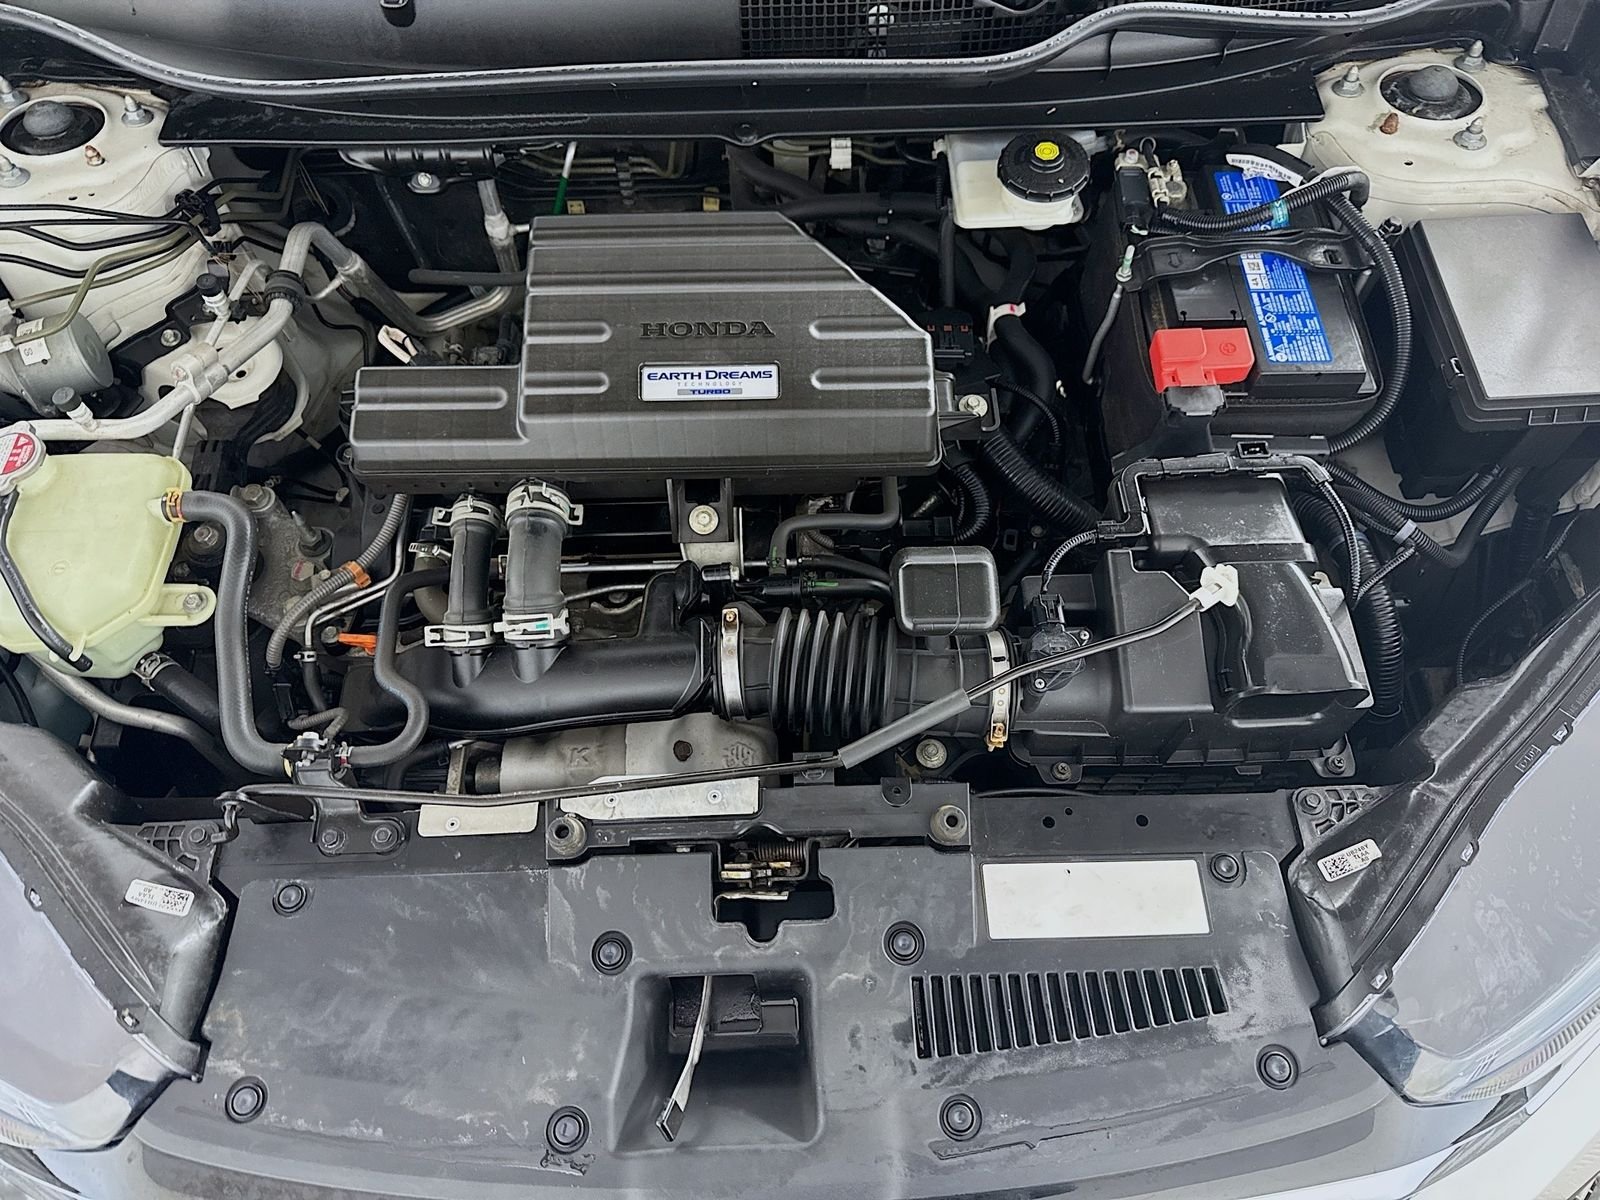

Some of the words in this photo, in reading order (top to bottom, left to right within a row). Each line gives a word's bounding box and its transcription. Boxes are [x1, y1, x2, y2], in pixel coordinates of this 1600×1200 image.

[640, 321, 776, 338] HONDA
[646, 371, 702, 381] EARTH
[705, 370, 773, 380] DREAMS
